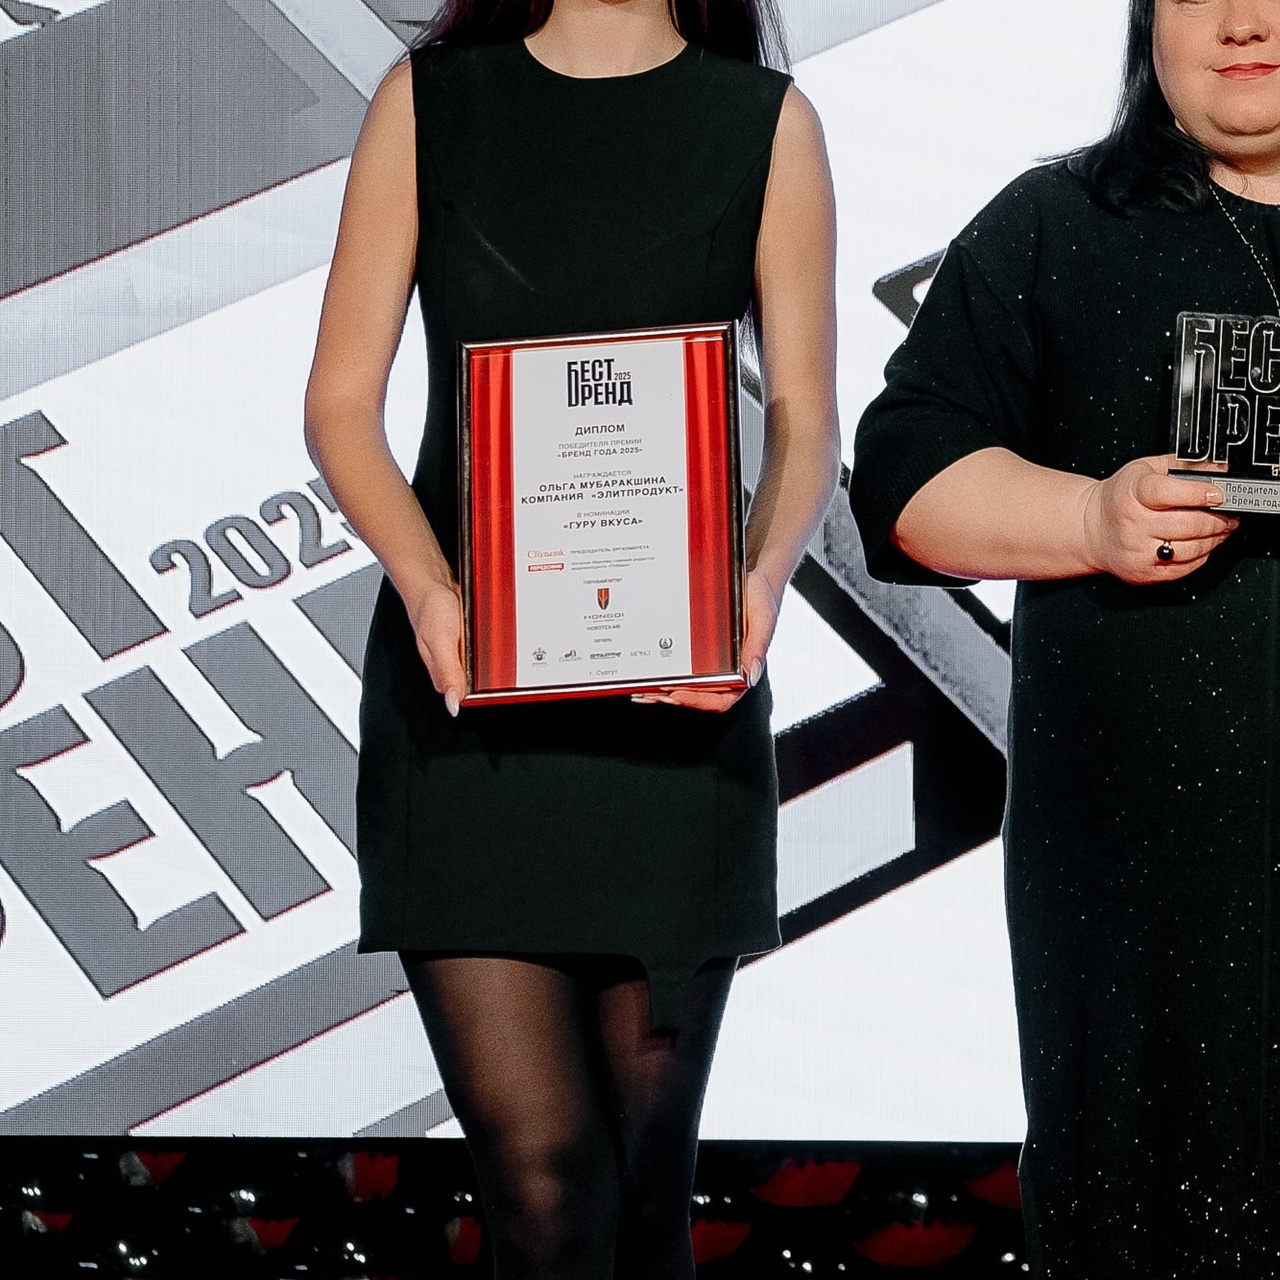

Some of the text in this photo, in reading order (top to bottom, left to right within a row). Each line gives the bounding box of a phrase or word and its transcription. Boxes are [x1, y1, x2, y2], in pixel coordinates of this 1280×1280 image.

[614, 372, 631, 381] 2025
[575, 424, 625, 436] ДИПЛОМ
[558, 439, 642, 450] ПОБЕДИТЕЛЯ ПРЕМИИ
[594, 448, 618, 457] ГОДА
[573, 470, 632, 480] НАГРАЖДАЕТСЯ
[539, 476, 667, 493] ОЛЬГА МУБАРАКШИНА
[1225, 483, 1279, 496] Победитель
[521, 485, 684, 504] КОМПАНИЯ «ЭЛИТПРОДУКТ»
[583, 509, 630, 518] НОМИНАЦИИ
[563, 517, 643, 530] «ГУРУ ВКУСА»
